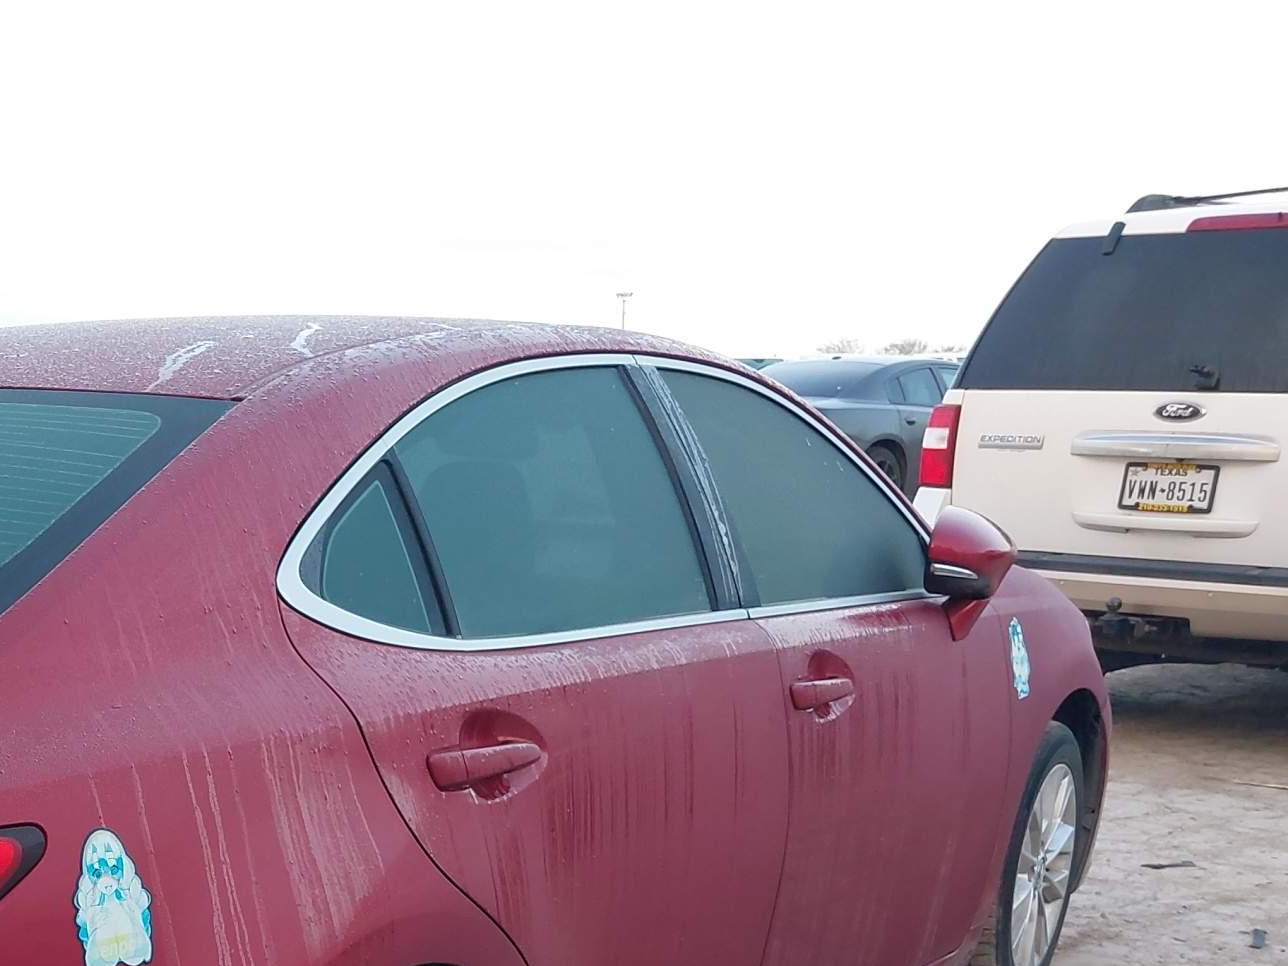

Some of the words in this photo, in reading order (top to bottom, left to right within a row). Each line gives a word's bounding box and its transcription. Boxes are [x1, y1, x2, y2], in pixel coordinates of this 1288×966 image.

[1162, 403, 1194, 417] Ford
[980, 434, 1041, 444] EXPEDITION
[1155, 467, 1188, 477] TEXAS
